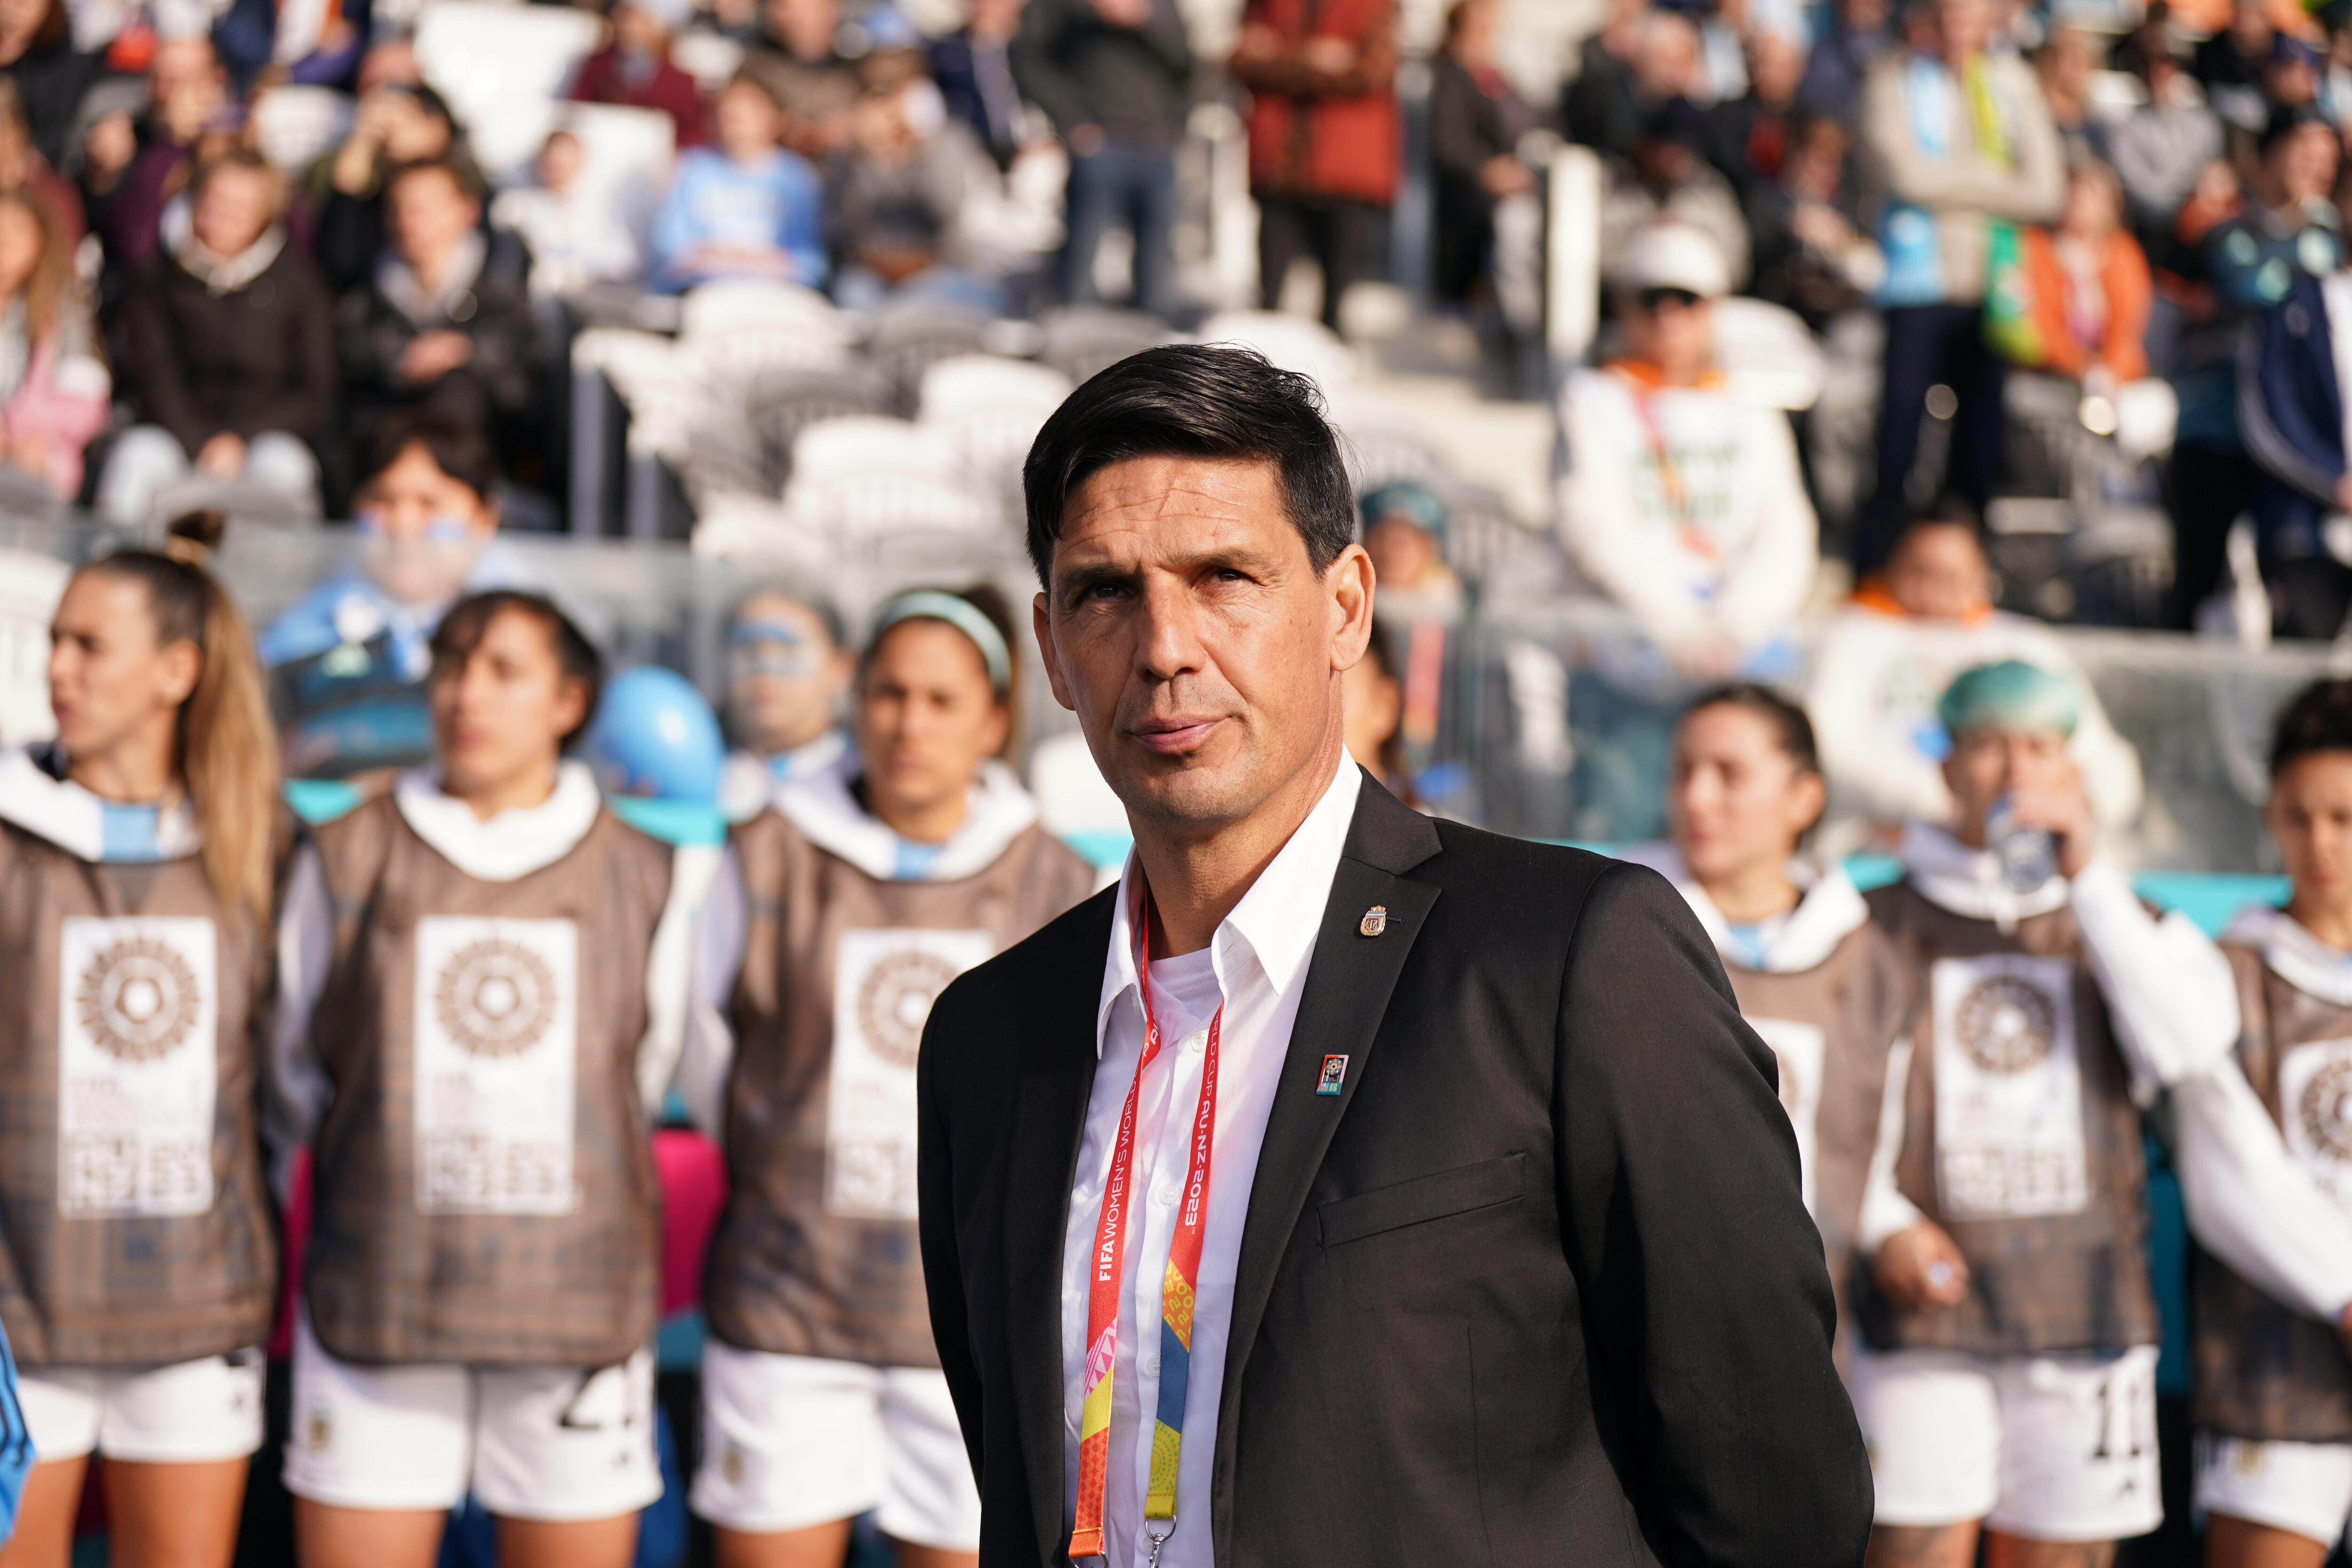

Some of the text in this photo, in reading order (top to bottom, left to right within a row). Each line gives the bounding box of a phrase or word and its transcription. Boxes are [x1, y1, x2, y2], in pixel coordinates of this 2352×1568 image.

[1206, 1059, 1215, 1097] CUP
[1099, 1081, 1136, 1281] FIFA WOMEN'S WORLD
